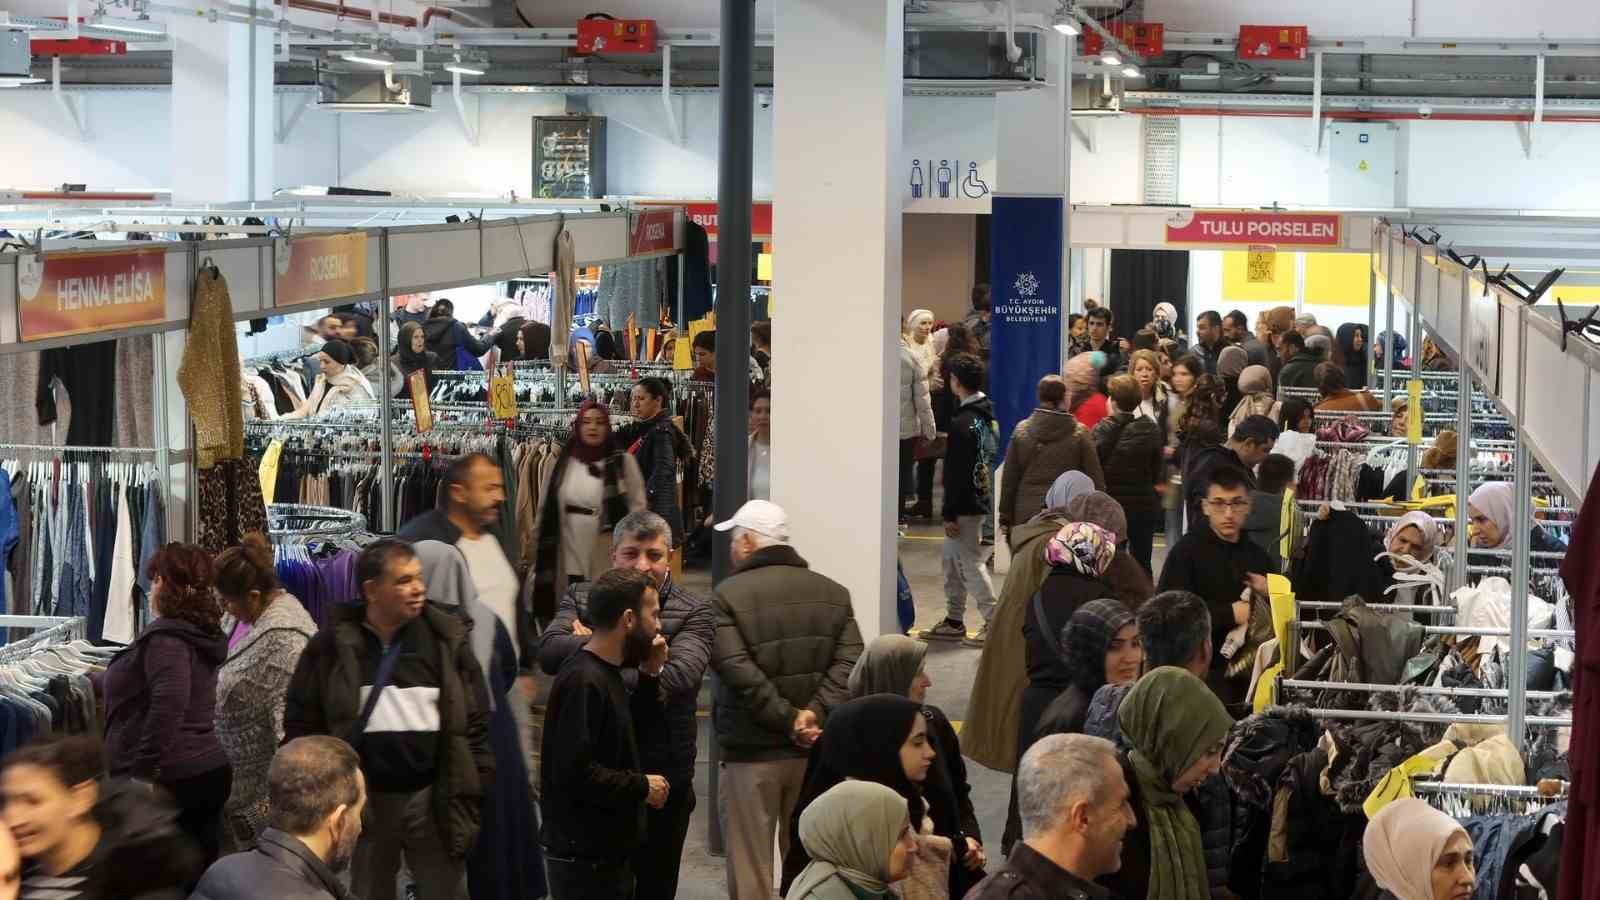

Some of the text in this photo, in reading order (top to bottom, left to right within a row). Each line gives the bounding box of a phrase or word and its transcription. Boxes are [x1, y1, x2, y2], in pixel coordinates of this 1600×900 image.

[1200, 220, 1244, 236] TULU
[1247, 221, 1335, 238] PORSELEN
[56, 264, 154, 312] HENNA ELİSA
[994, 304, 1057, 317] BÜYÜKŞEHİR
